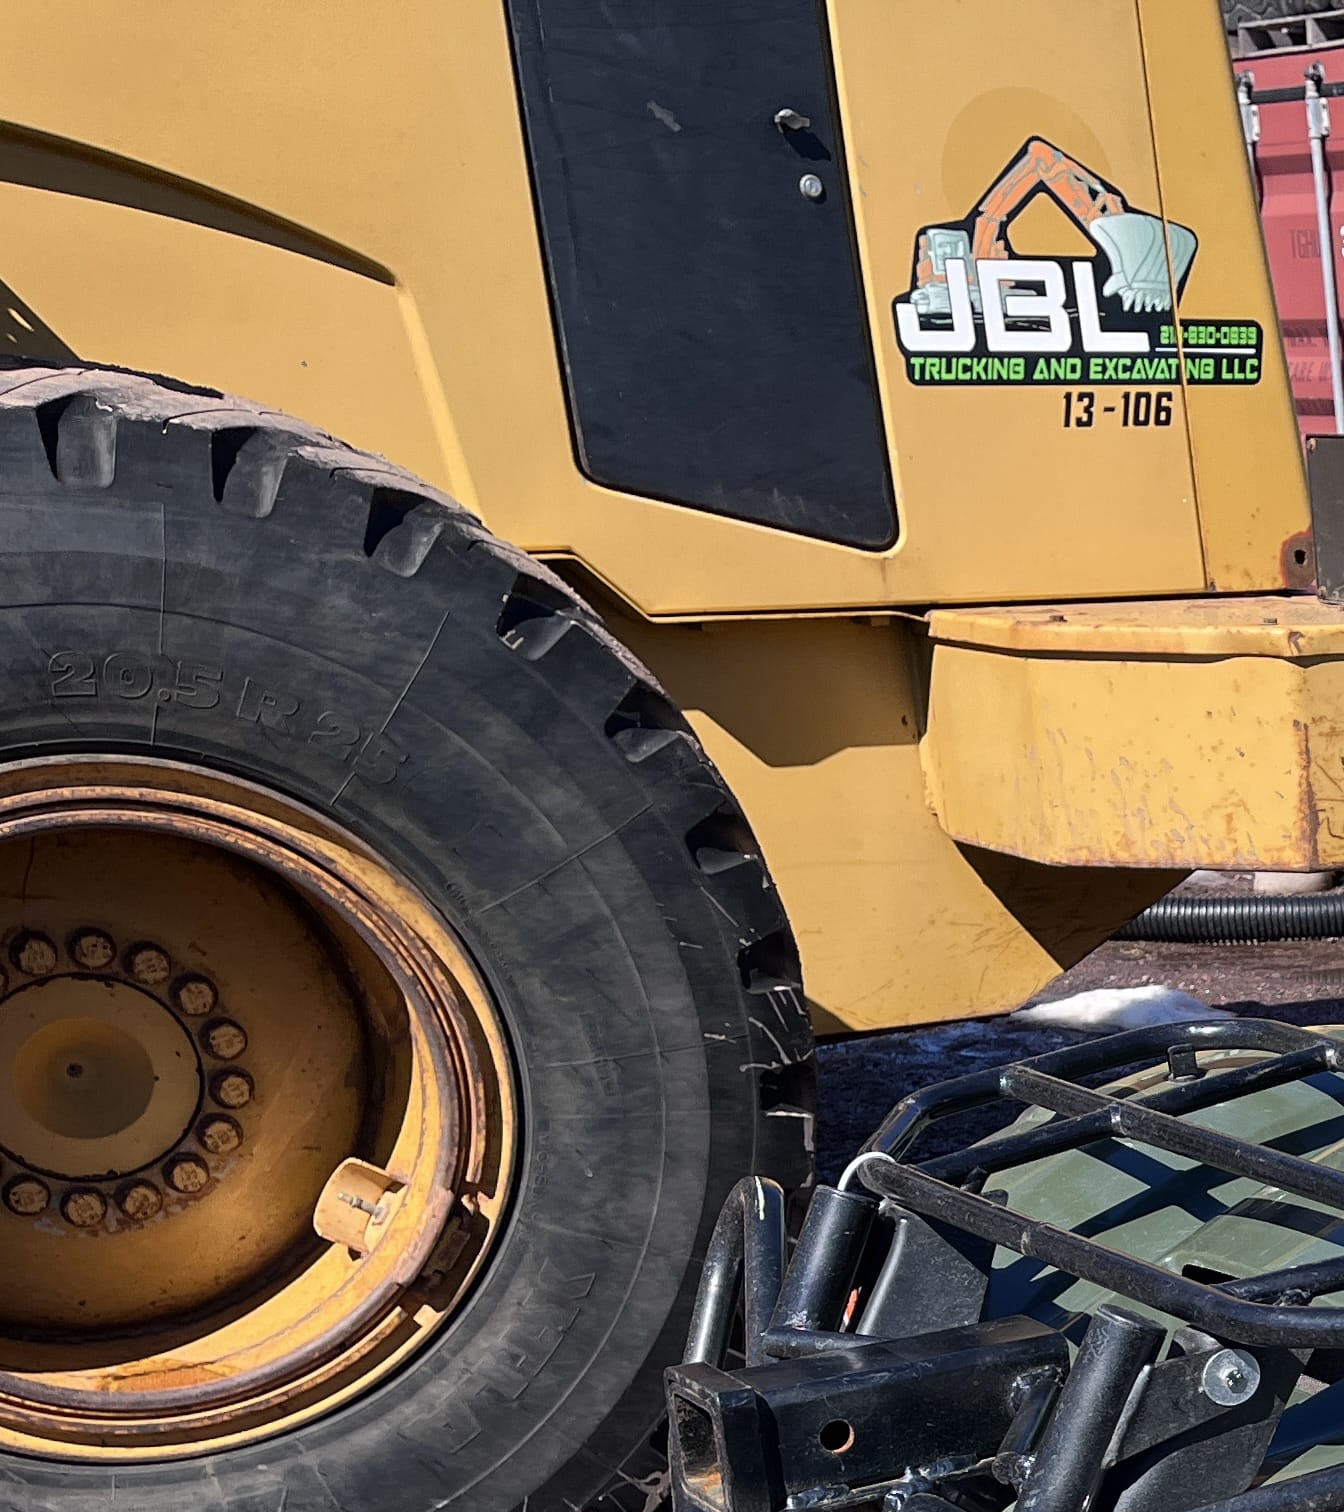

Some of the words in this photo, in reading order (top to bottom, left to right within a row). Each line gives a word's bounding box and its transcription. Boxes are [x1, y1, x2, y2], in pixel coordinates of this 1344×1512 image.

[896, 258, 1150, 353] JBL
[1160, 325, 1258, 345] 21-830-0839
[910, 357, 1026, 381] TRUCKING
[1033, 357, 1082, 381] AND
[1089, 357, 1214, 381] EXCAVATNG
[1221, 358, 1259, 380] LLC
